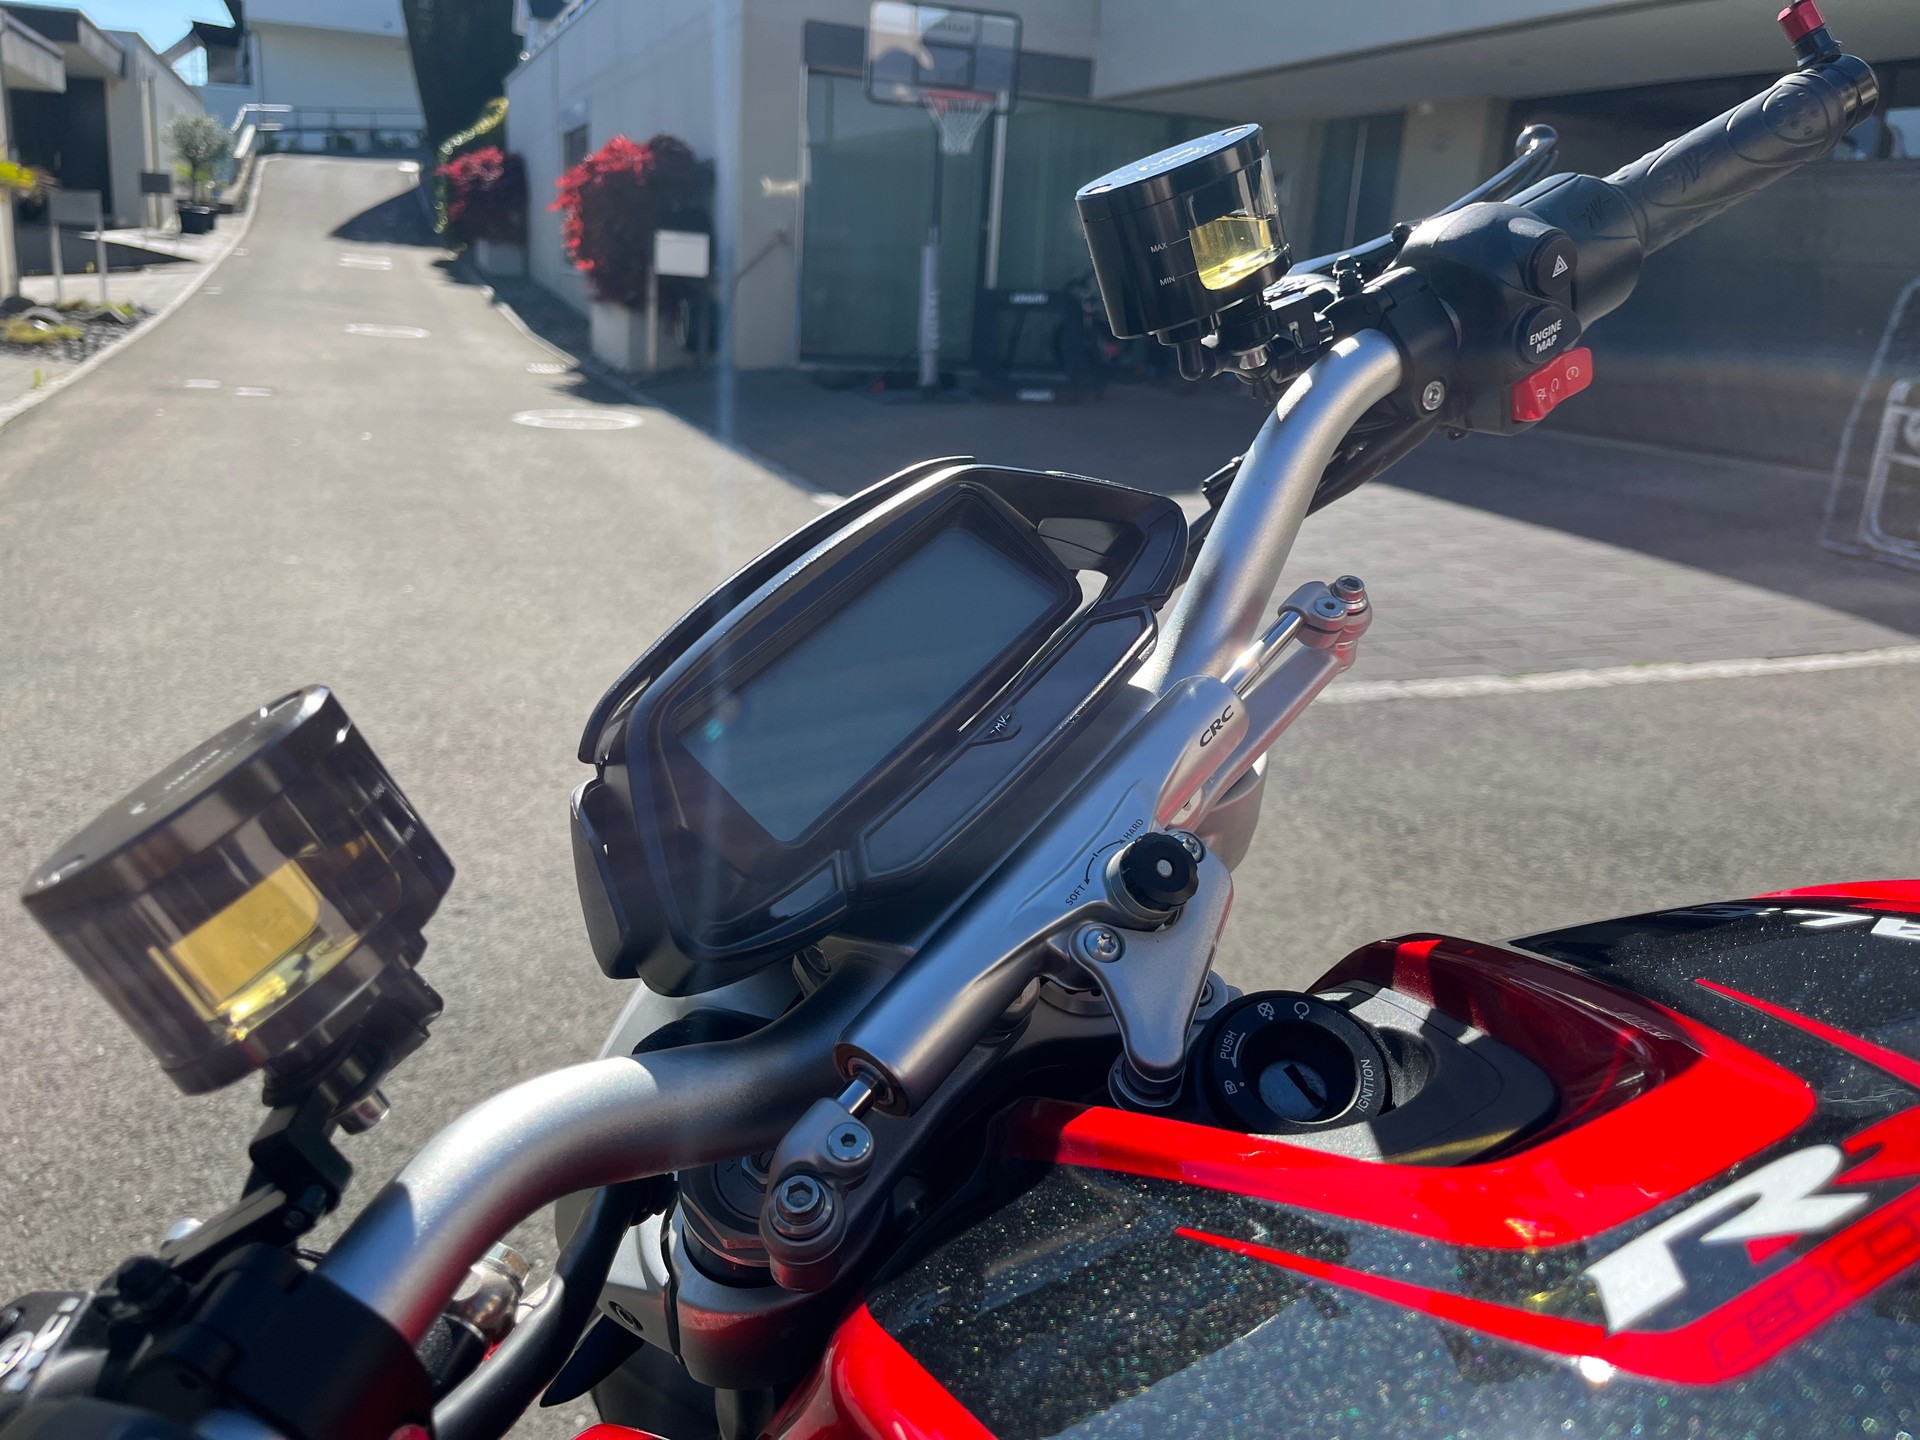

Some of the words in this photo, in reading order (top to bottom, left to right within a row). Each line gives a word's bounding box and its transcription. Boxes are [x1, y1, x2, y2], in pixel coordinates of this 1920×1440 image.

[1150, 242, 1168, 253] MAX
[1159, 276, 1176, 286] MIN
[1529, 319, 1562, 345] ENGINE
[1536, 334, 1557, 354] MAP
[1199, 704, 1234, 747] CRC
[1123, 818, 1144, 840] HARD
[1065, 884, 1086, 906] SOFT
[1220, 1030, 1237, 1060] PUSH
[1356, 1059, 1374, 1112] IGNITION
